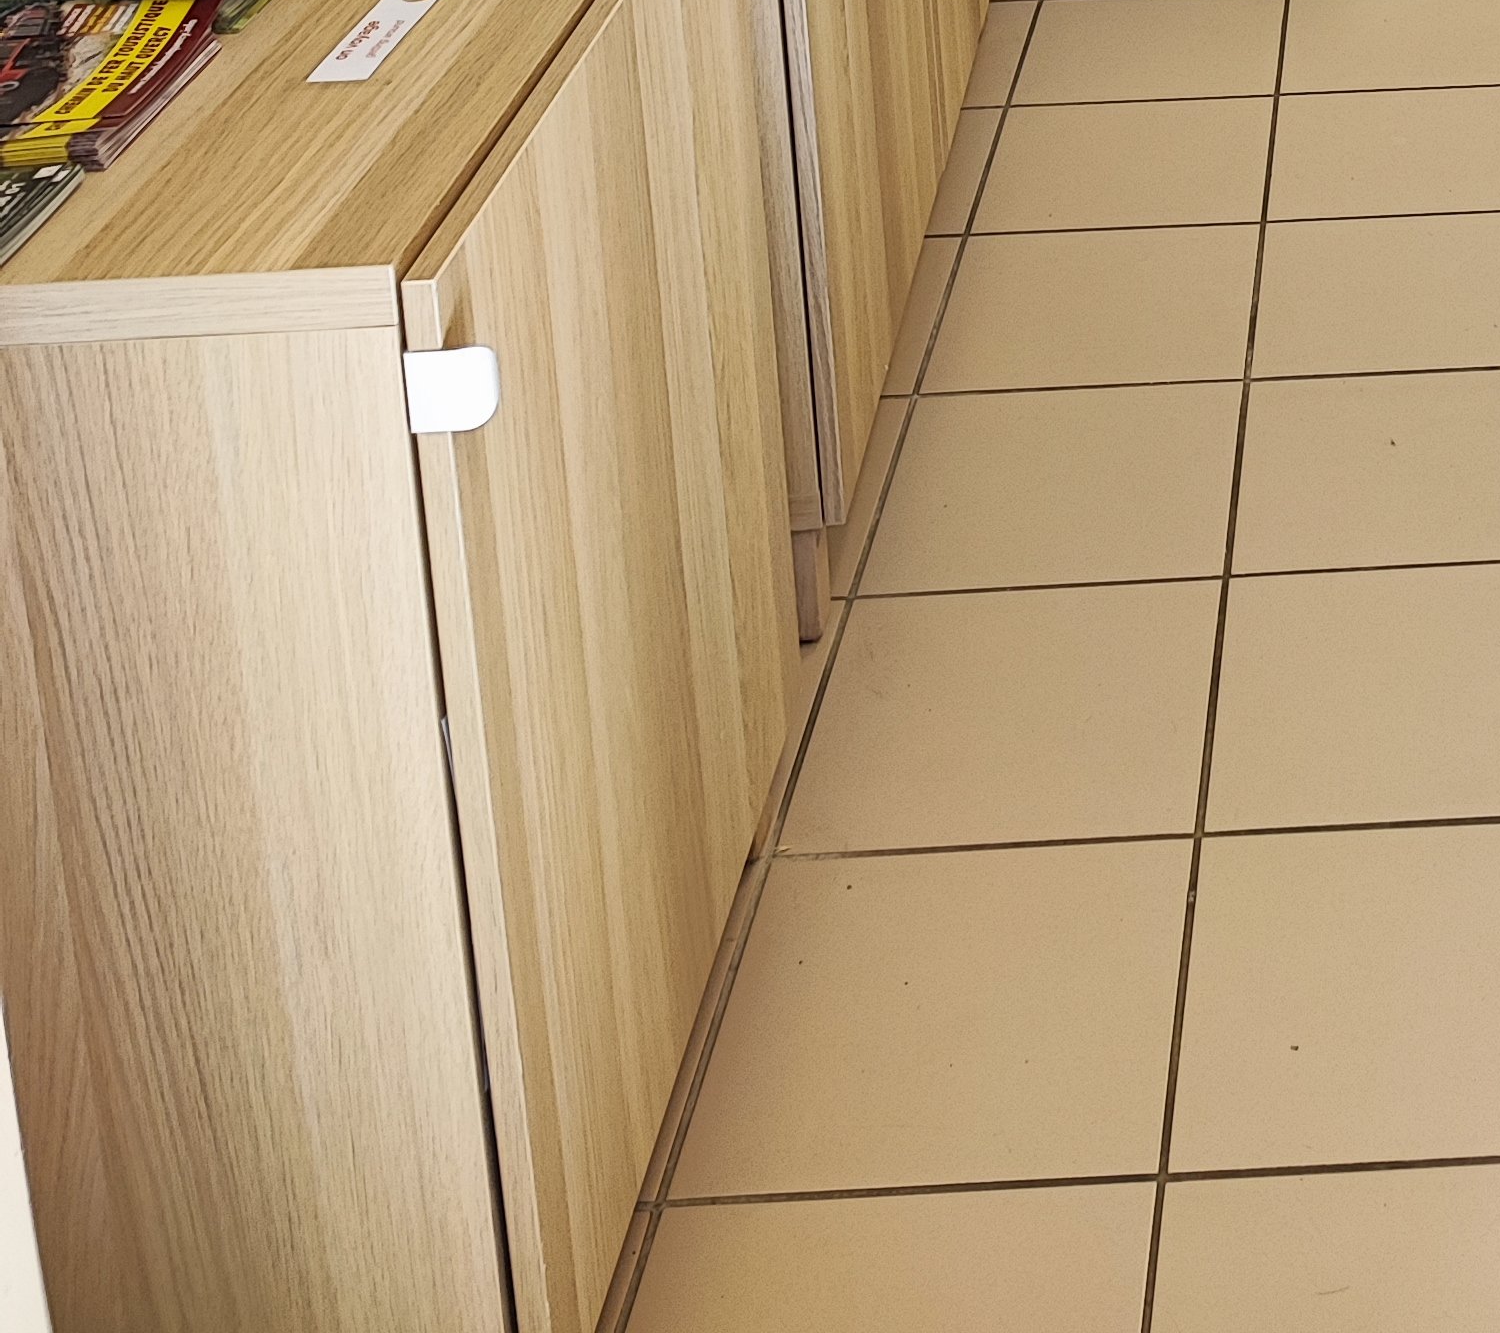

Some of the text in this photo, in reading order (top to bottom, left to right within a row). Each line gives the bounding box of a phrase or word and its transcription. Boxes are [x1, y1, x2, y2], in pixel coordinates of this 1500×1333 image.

[54, 84, 96, 116] CHEMIN
[91, 71, 107, 87] DE
[99, 59, 119, 76] FER
[101, 26, 172, 93] DU HAUT QUERCY
